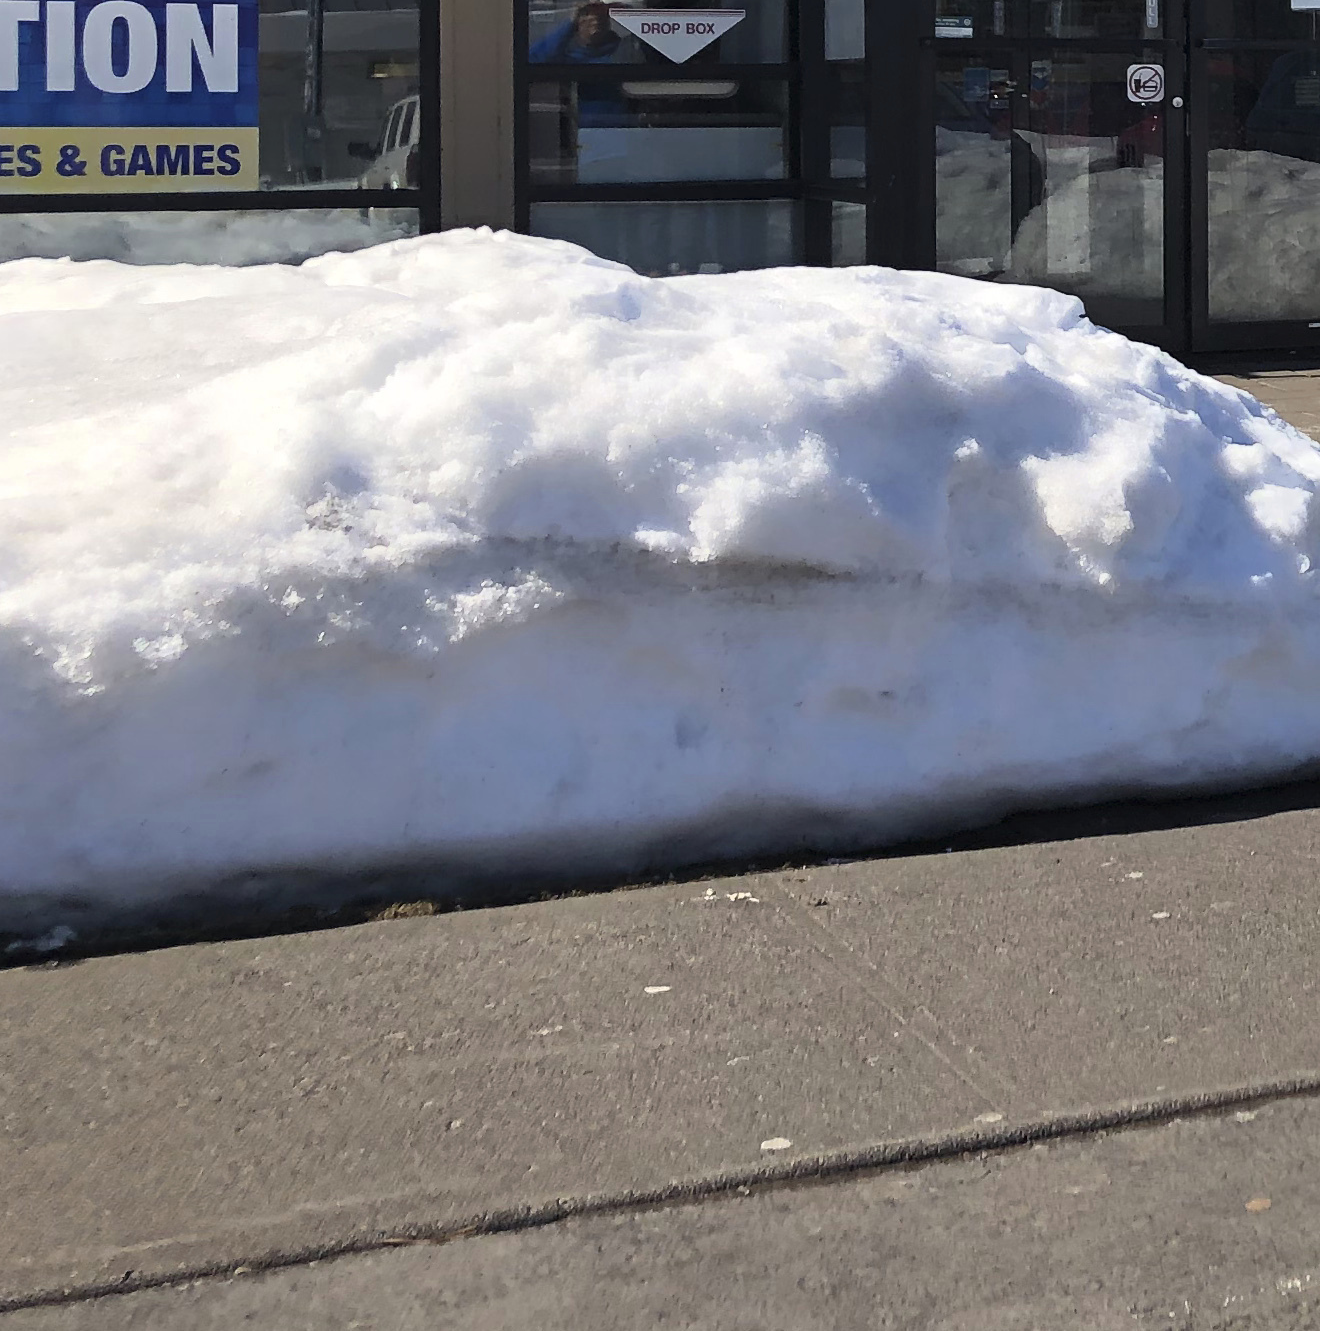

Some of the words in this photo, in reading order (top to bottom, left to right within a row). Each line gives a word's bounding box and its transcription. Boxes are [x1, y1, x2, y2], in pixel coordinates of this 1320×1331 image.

[641, 22, 680, 34] DROP
[686, 23, 715, 35] BOX
[56, 145, 87, 176] &
[100, 144, 241, 177] GAMES
